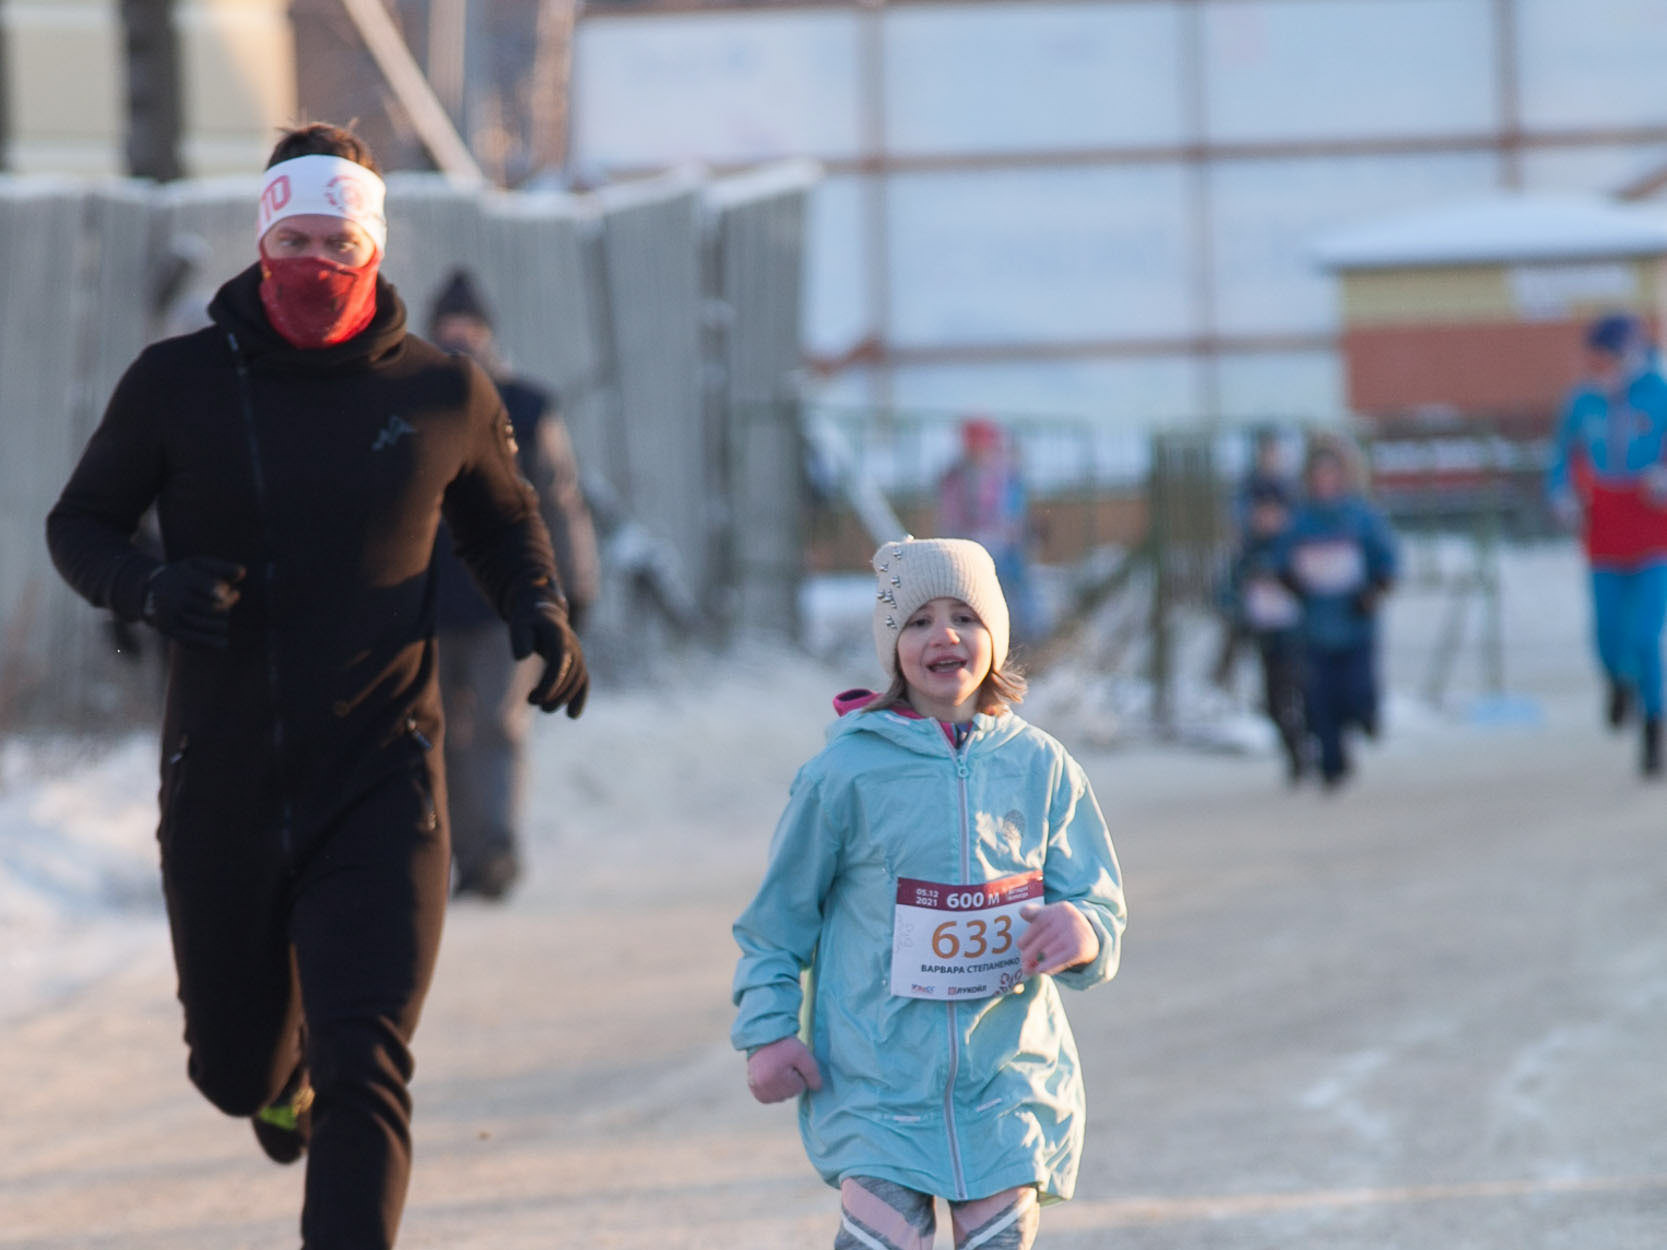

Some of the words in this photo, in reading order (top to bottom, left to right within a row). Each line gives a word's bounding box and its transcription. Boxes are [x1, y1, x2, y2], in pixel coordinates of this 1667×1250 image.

[916, 888, 939, 898] 05.12
[916, 896, 938, 907] 2021
[946, 891, 984, 909] 600
[932, 915, 1012, 959] 633
[921, 963, 965, 974] ВАРВАРА
[966, 956, 1021, 974] СТЕПАНЕНКО
